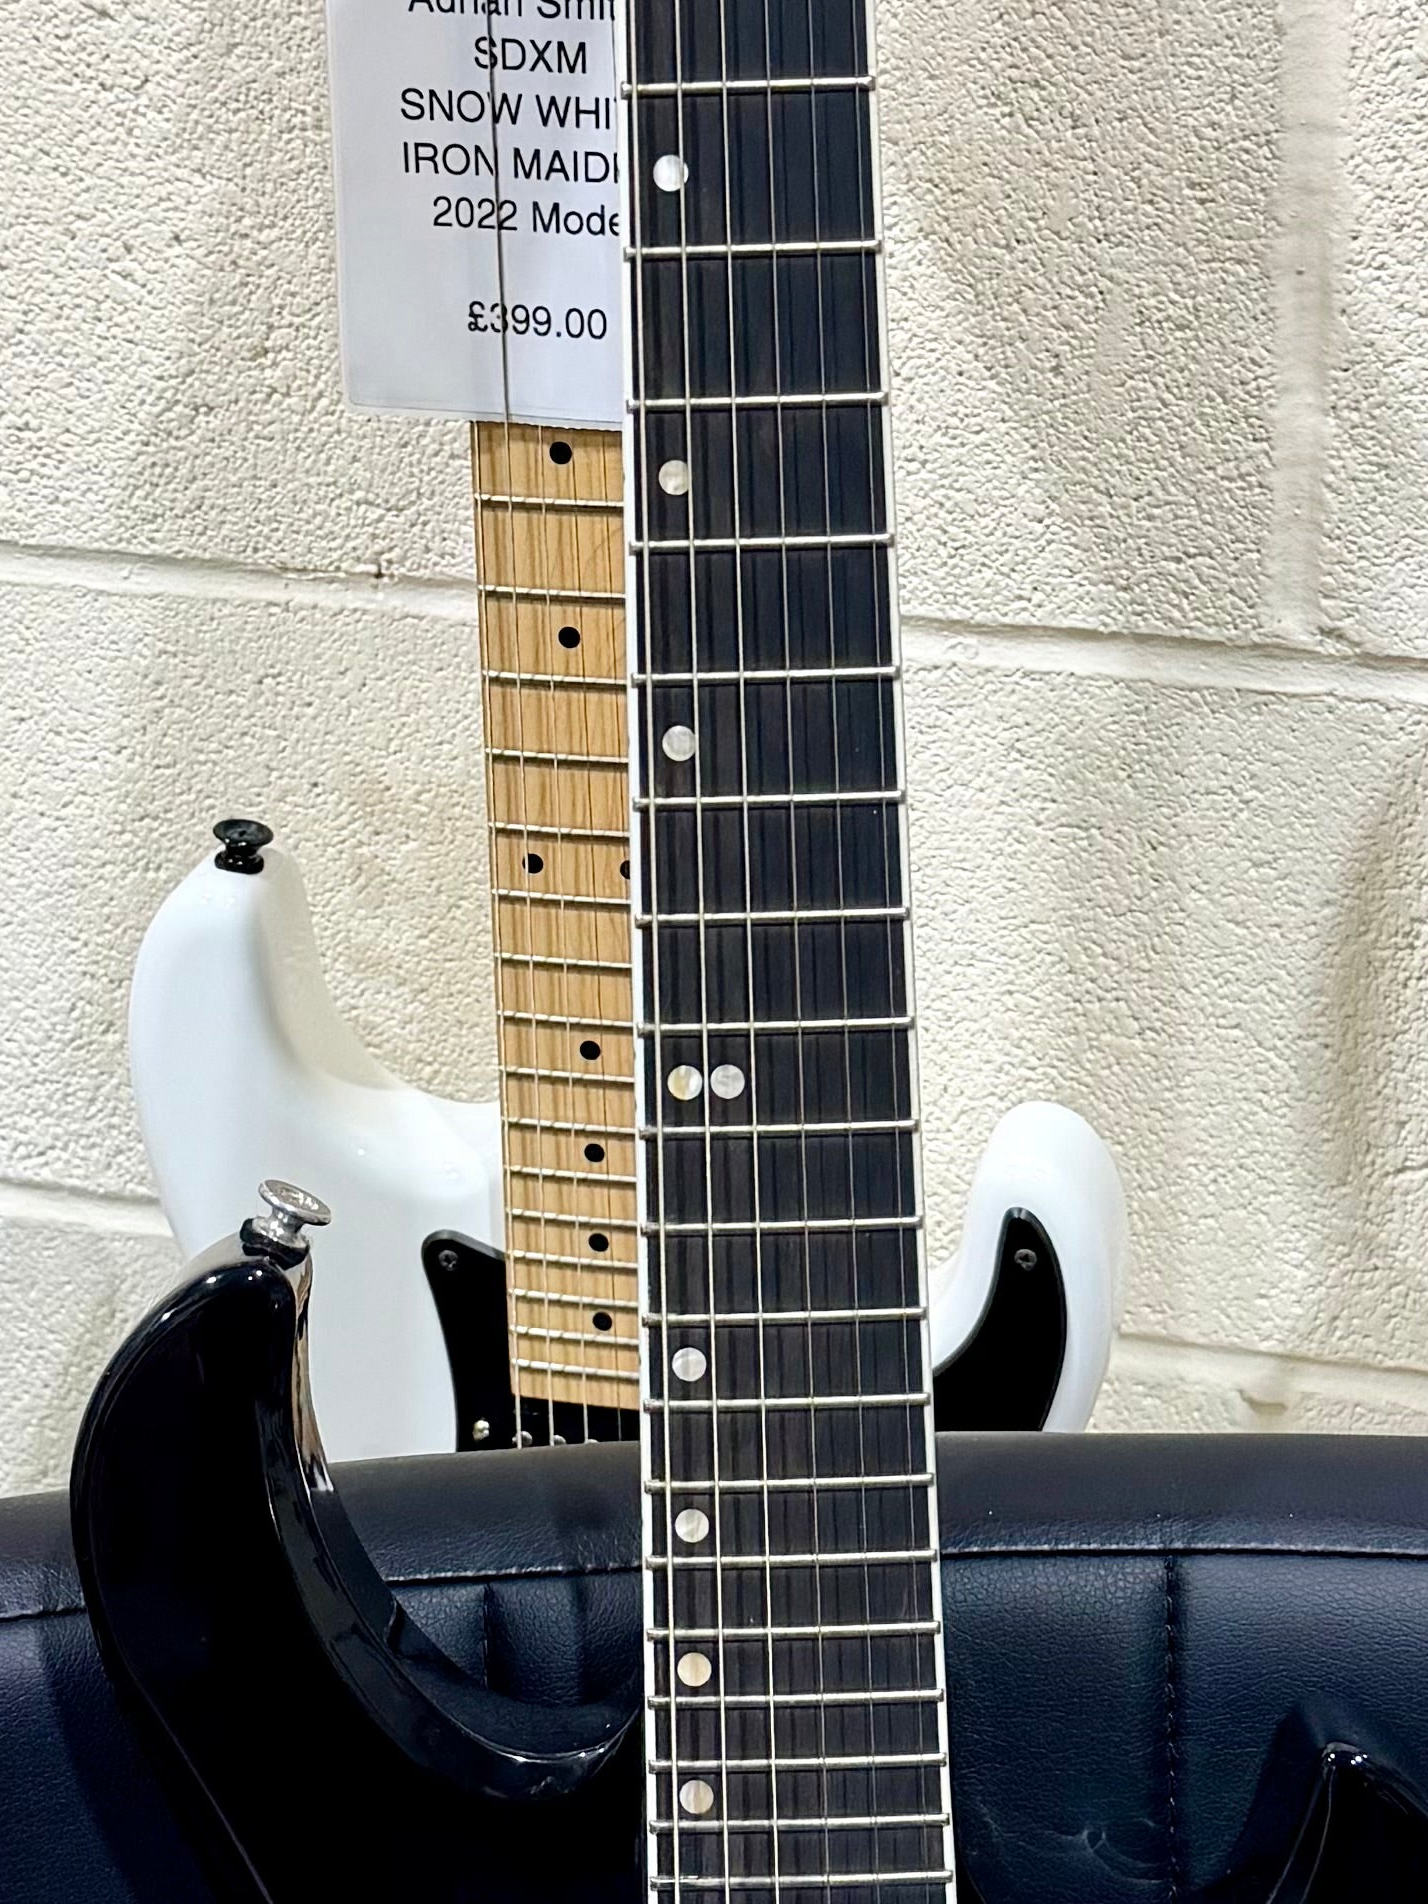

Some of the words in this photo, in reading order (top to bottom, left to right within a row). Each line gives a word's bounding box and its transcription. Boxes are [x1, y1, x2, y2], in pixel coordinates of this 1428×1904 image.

[473, 36, 588, 74] SDXM
[400, 87, 524, 126] SNOW
[534, 93, 618, 131] WHI
[402, 141, 499, 177] IRON
[512, 146, 619, 184] MAID
[432, 195, 519, 232] 2022
[531, 200, 620, 237] Mode
[467, 300, 609, 341] £399.00
